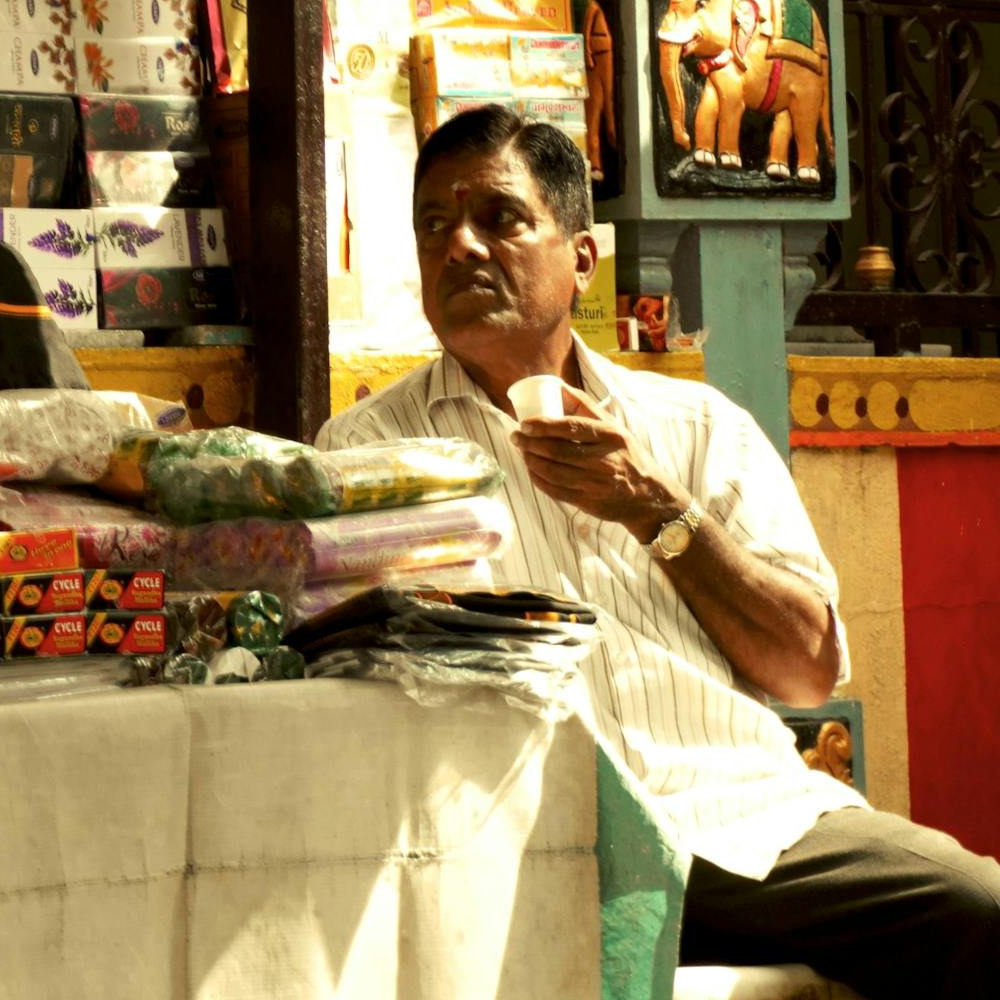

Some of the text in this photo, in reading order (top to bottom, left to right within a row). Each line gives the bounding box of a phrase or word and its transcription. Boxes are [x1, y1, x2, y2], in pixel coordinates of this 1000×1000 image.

[13, 35, 25, 86] CHAMPA
[173, 212, 186, 263] LAVENDER
[570, 304, 605, 320] asturi
[52, 578, 81, 592] CYCLE
[133, 577, 161, 589] CYCLE
[54, 621, 83, 633] CYCLE
[134, 620, 162, 632] CYCLE
